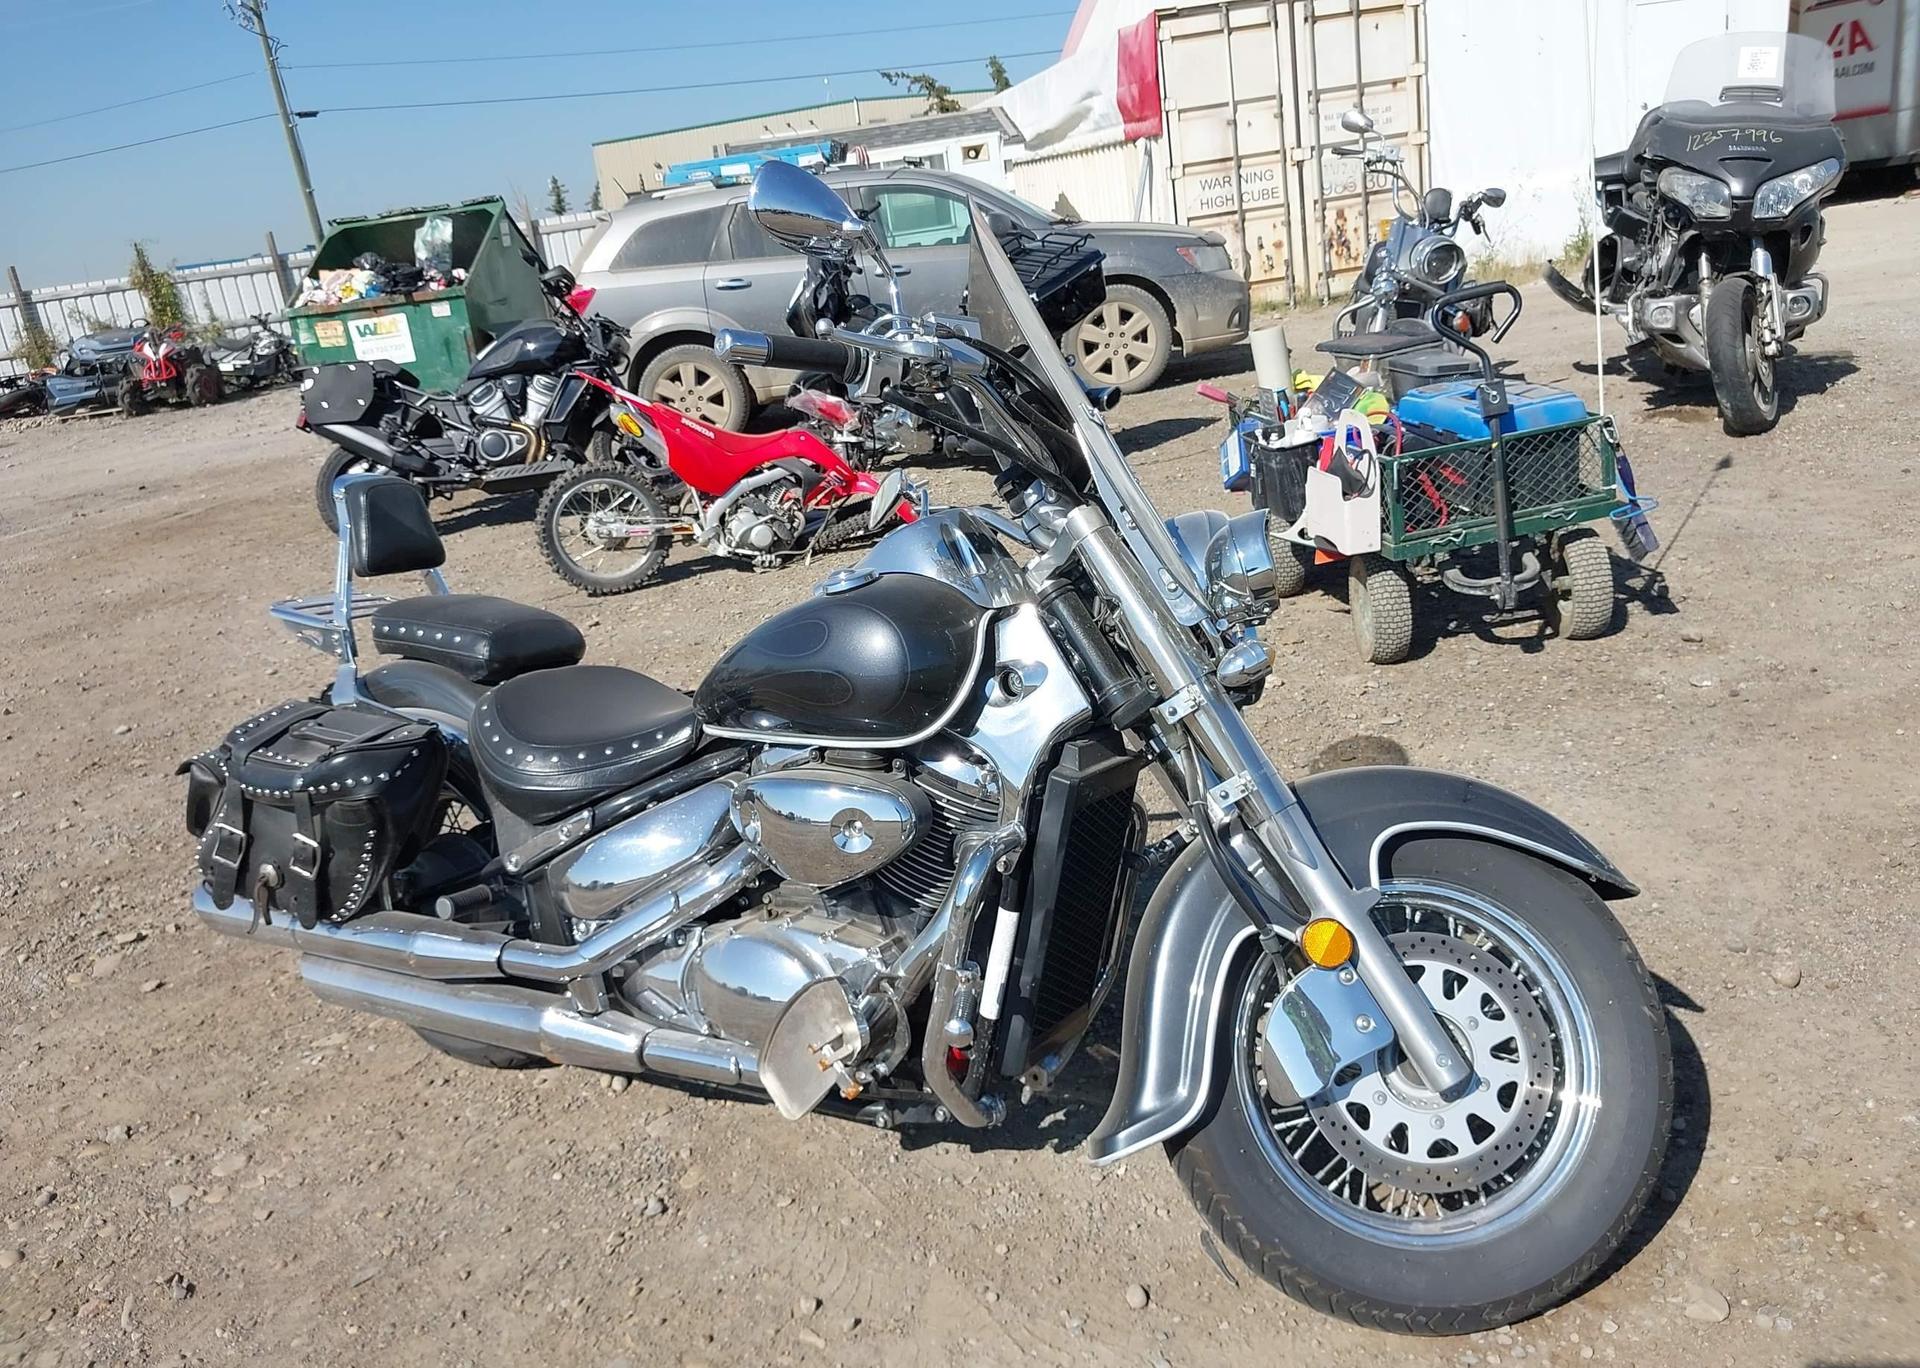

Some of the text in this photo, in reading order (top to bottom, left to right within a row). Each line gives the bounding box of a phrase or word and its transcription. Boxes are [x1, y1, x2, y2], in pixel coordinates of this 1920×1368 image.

[1686, 129, 1783, 152] 12357996
[1200, 187, 1280, 210] HIGH CUBE
[681, 417, 715, 439] HONDA
